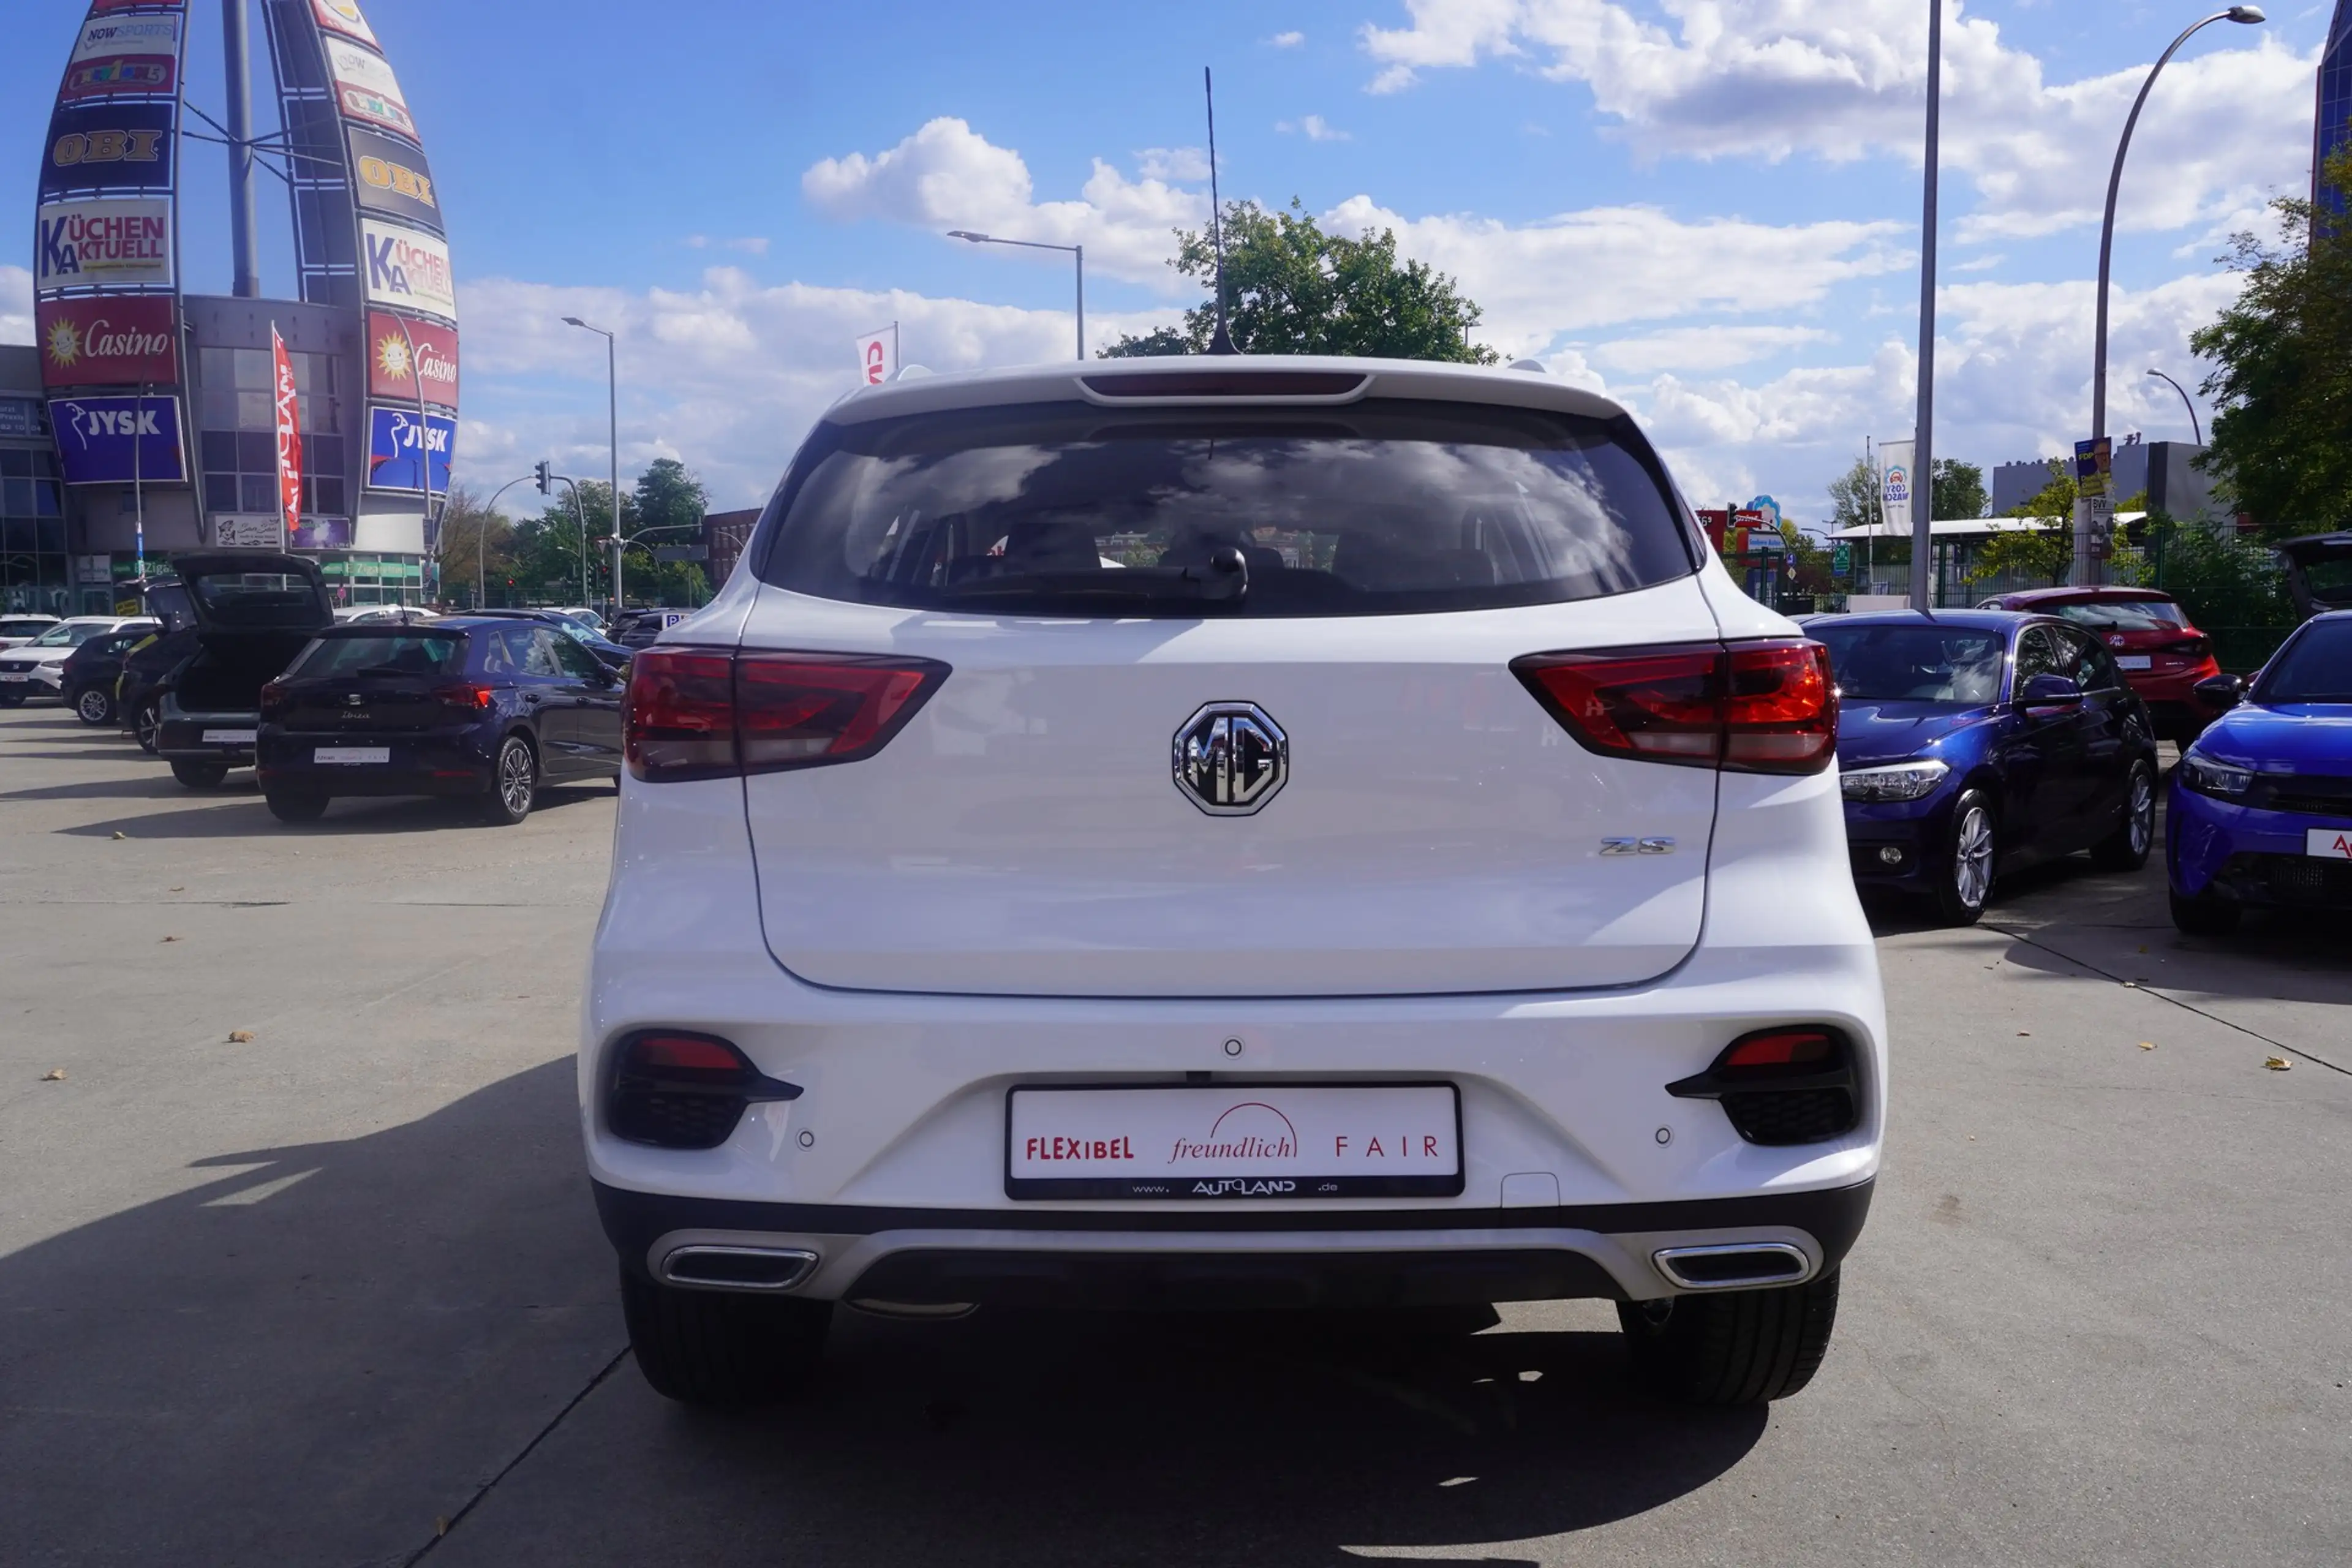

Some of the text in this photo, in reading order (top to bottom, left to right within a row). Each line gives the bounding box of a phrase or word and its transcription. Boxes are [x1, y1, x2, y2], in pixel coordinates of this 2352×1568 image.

[53, 130, 163, 167] OBI
[360, 156, 435, 208] OBI
[85, 319, 168, 358] Casino
[415, 342, 456, 383] Casino
[89, 410, 162, 435] JYSK
[403, 425, 448, 452] JYSK
[2078, 451, 2094, 461] FDP
[1187, 717, 1273, 802] MG
[1599, 837, 1676, 856] ZS
[1027, 1136, 1439, 1164] FLEXIBEL freundlich FAIR
[1133, 1178, 1339, 1196] www. AUTOLAND .de
